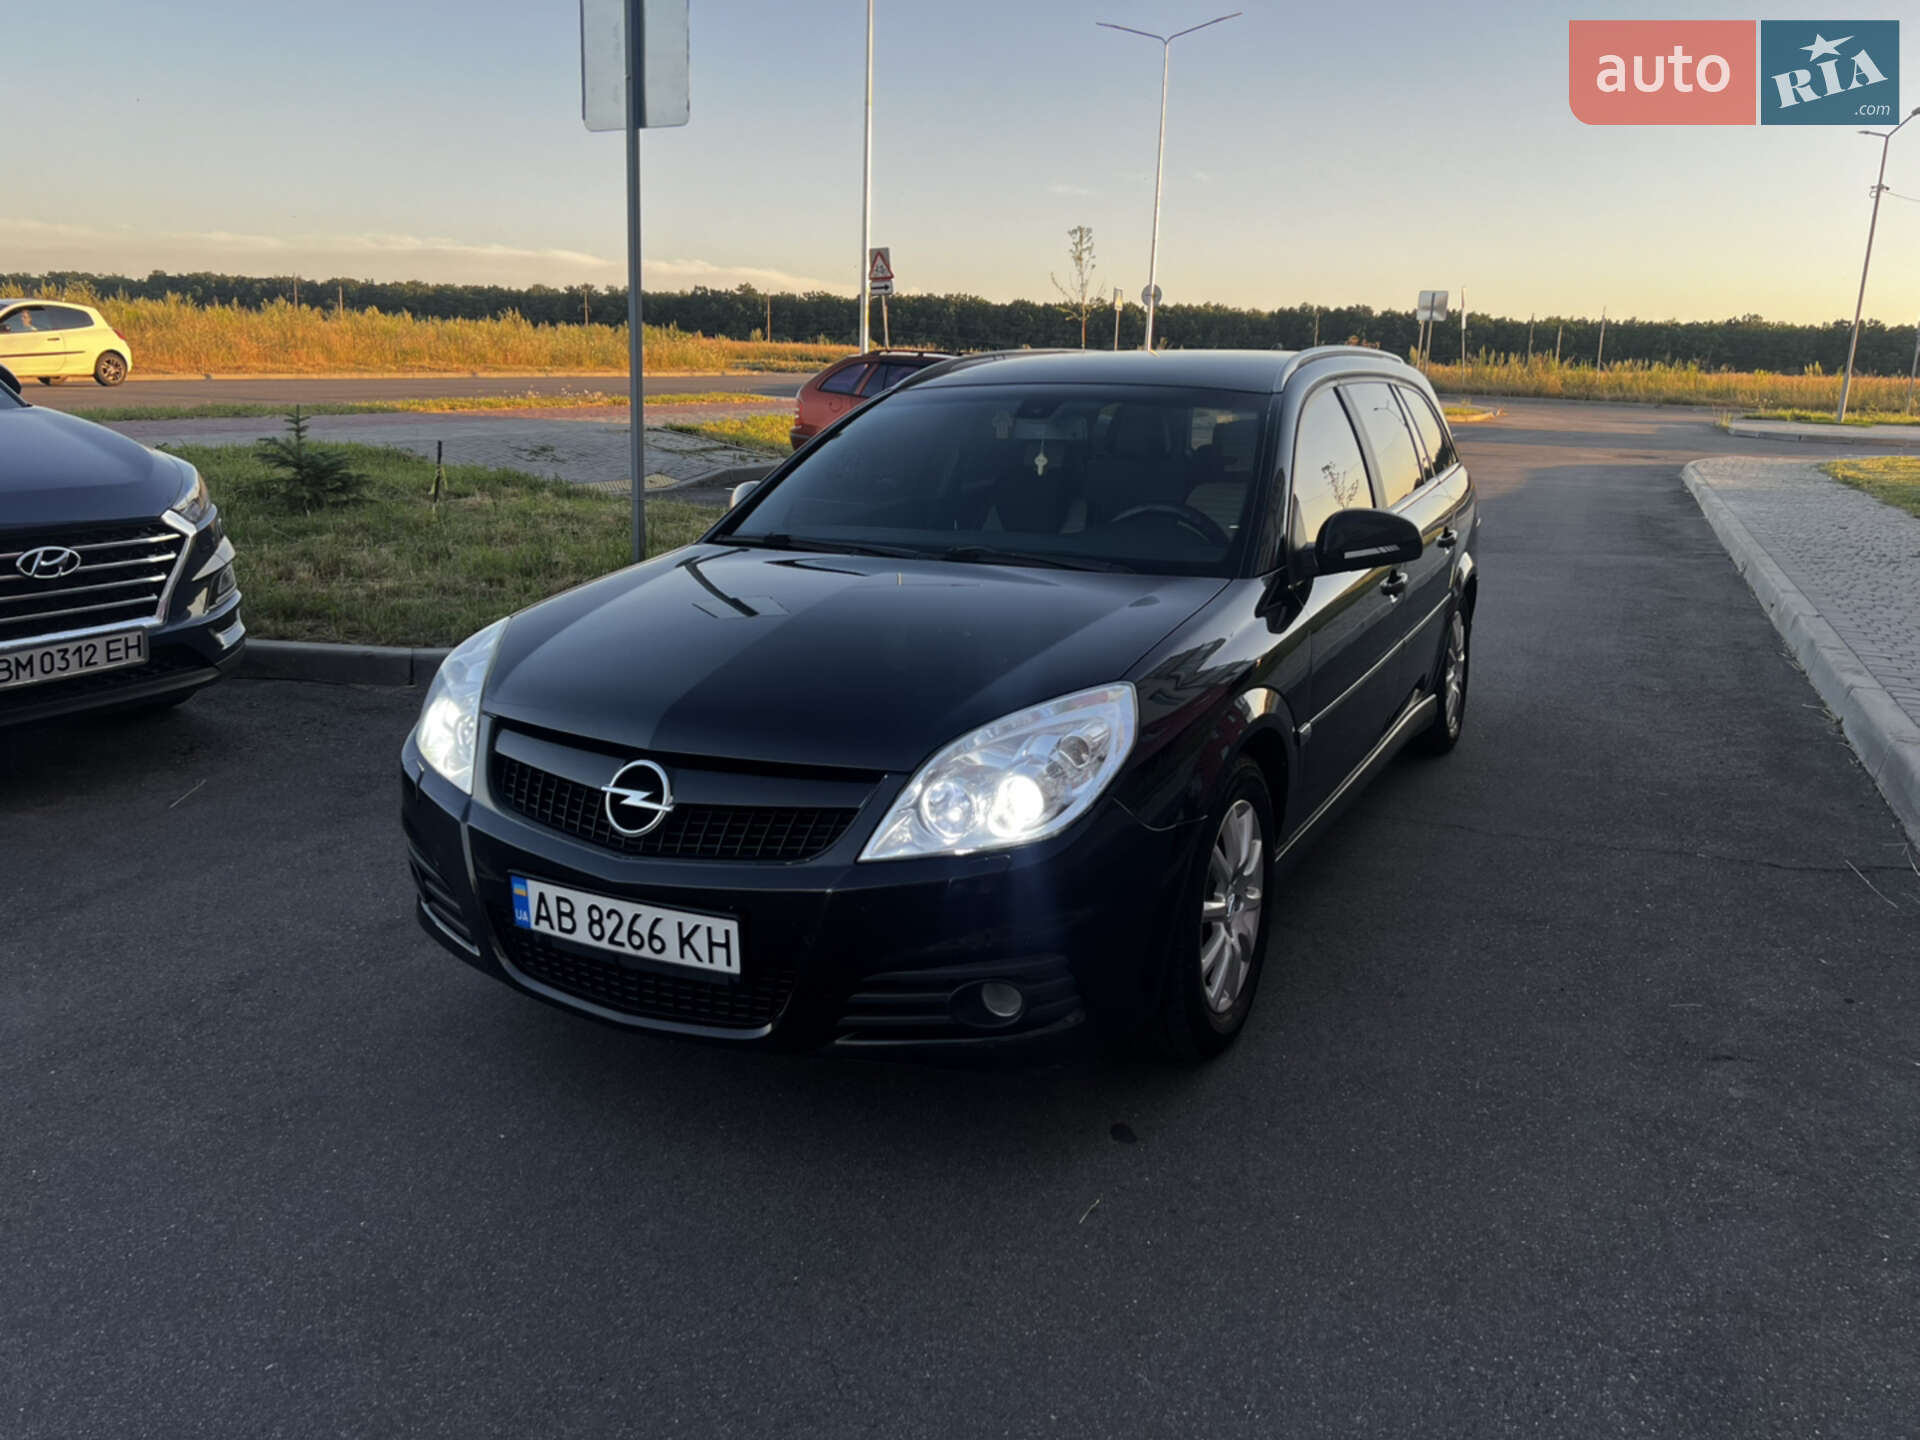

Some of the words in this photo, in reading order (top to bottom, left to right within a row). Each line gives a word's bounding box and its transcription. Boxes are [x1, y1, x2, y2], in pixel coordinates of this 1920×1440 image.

[0, 654, 34, 682] BM
[40, 644, 97, 674] 0312
[106, 635, 142, 662] EH
[515, 909, 529, 921] UA
[534, 891, 577, 935] AB
[587, 904, 666, 955] 8266
[677, 921, 732, 967] KH
